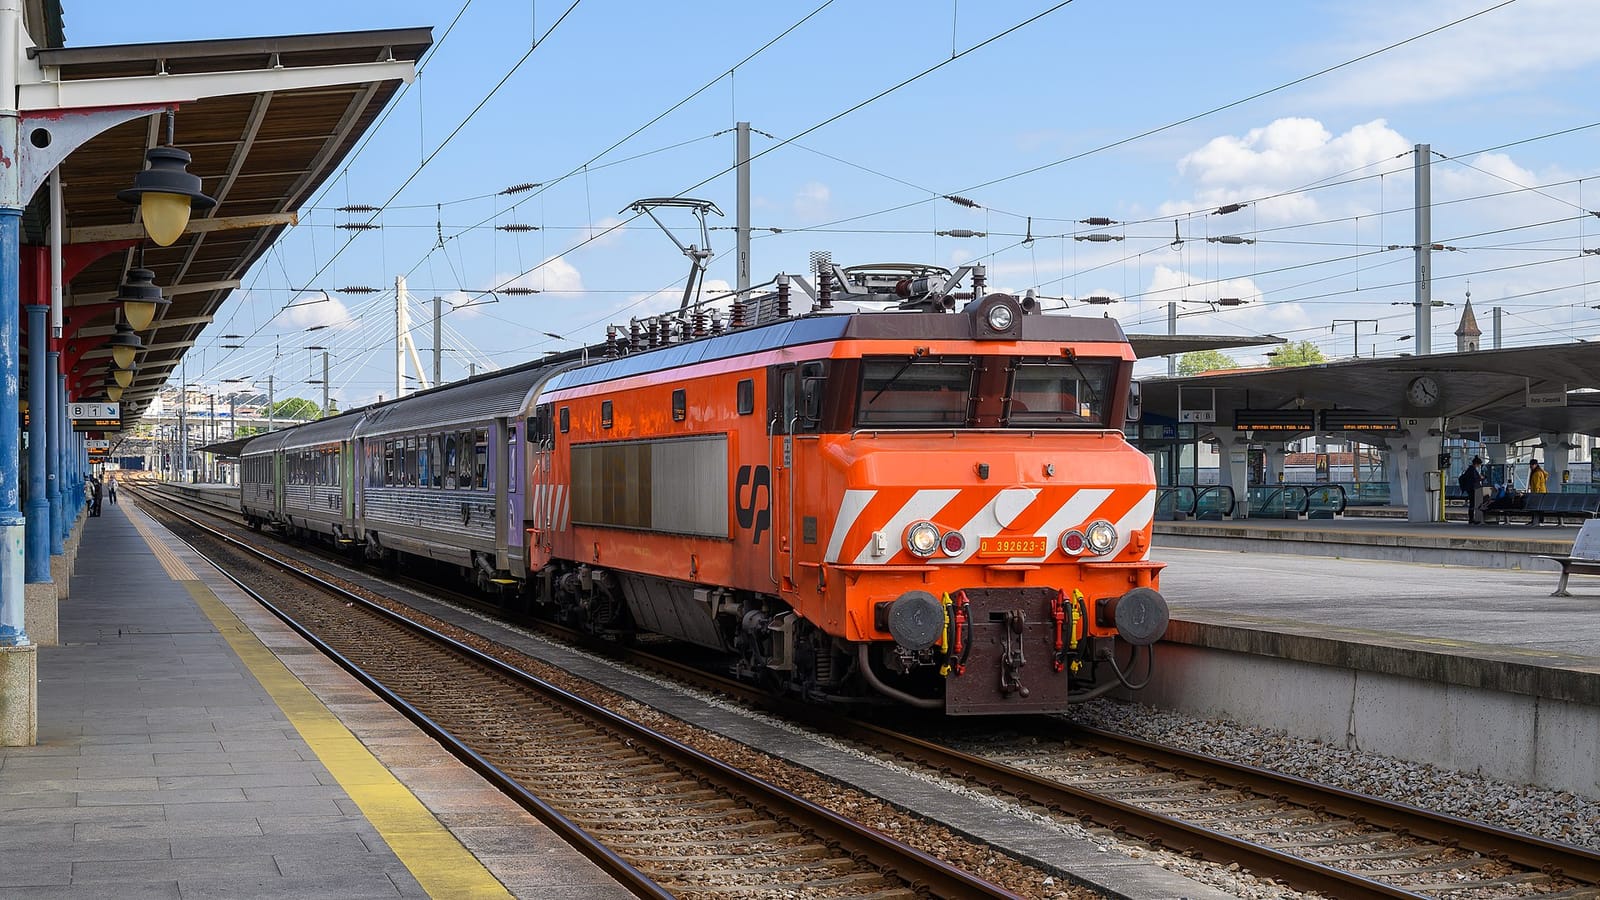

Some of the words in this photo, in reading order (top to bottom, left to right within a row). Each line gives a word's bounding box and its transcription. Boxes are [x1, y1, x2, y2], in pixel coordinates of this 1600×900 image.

[74, 407, 82, 415] B
[735, 465, 772, 544] CP
[997, 541, 1046, 551] 392623-3
